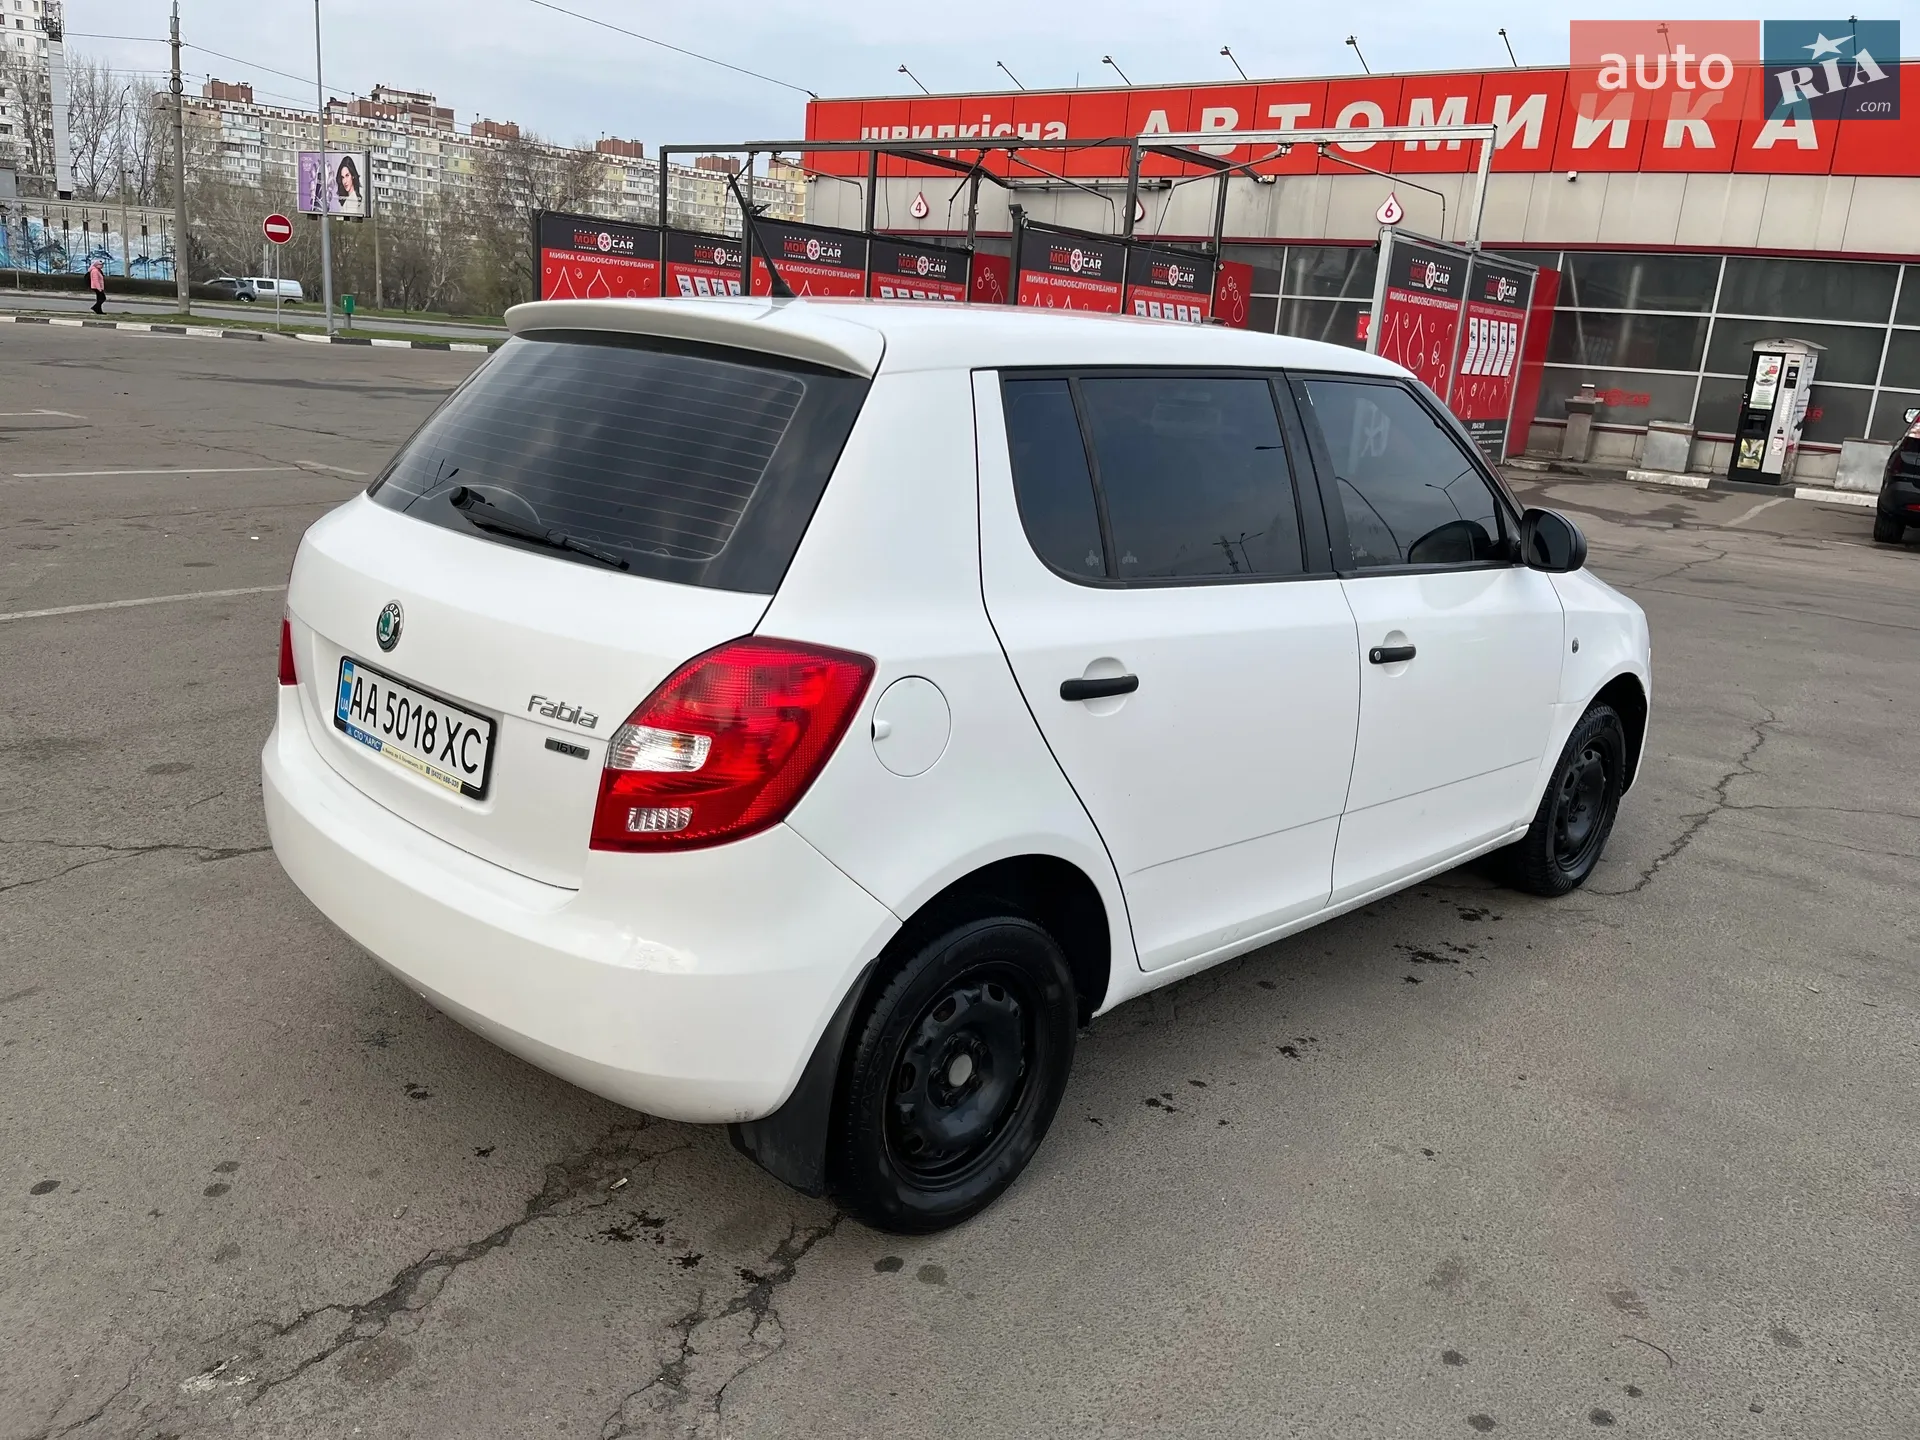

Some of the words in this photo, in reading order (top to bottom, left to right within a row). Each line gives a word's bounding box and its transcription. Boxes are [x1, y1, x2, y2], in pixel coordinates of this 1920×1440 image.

[915, 202, 922, 213] 4
[1384, 203, 1394, 218] 6
[574, 234, 597, 245] МОЙ
[612, 239, 634, 250] CAR
[549, 251, 575, 261] МИЙКА
[784, 241, 806, 253] МОЙ
[821, 247, 842, 258] CAR
[1050, 252, 1070, 264] МОЙ
[1083, 257, 1102, 269] CAR
[929, 263, 947, 274] CAR
[1178, 272, 1195, 283] CAR
[1434, 271, 1450, 285] CAR
[1505, 285, 1517, 297] CAR
[341, 697, 349, 712] UA
[527, 694, 599, 729] Fabia
[349, 676, 377, 728] AA
[382, 690, 437, 755] 5018
[439, 716, 482, 775] XC
[556, 742, 578, 755] 16V
